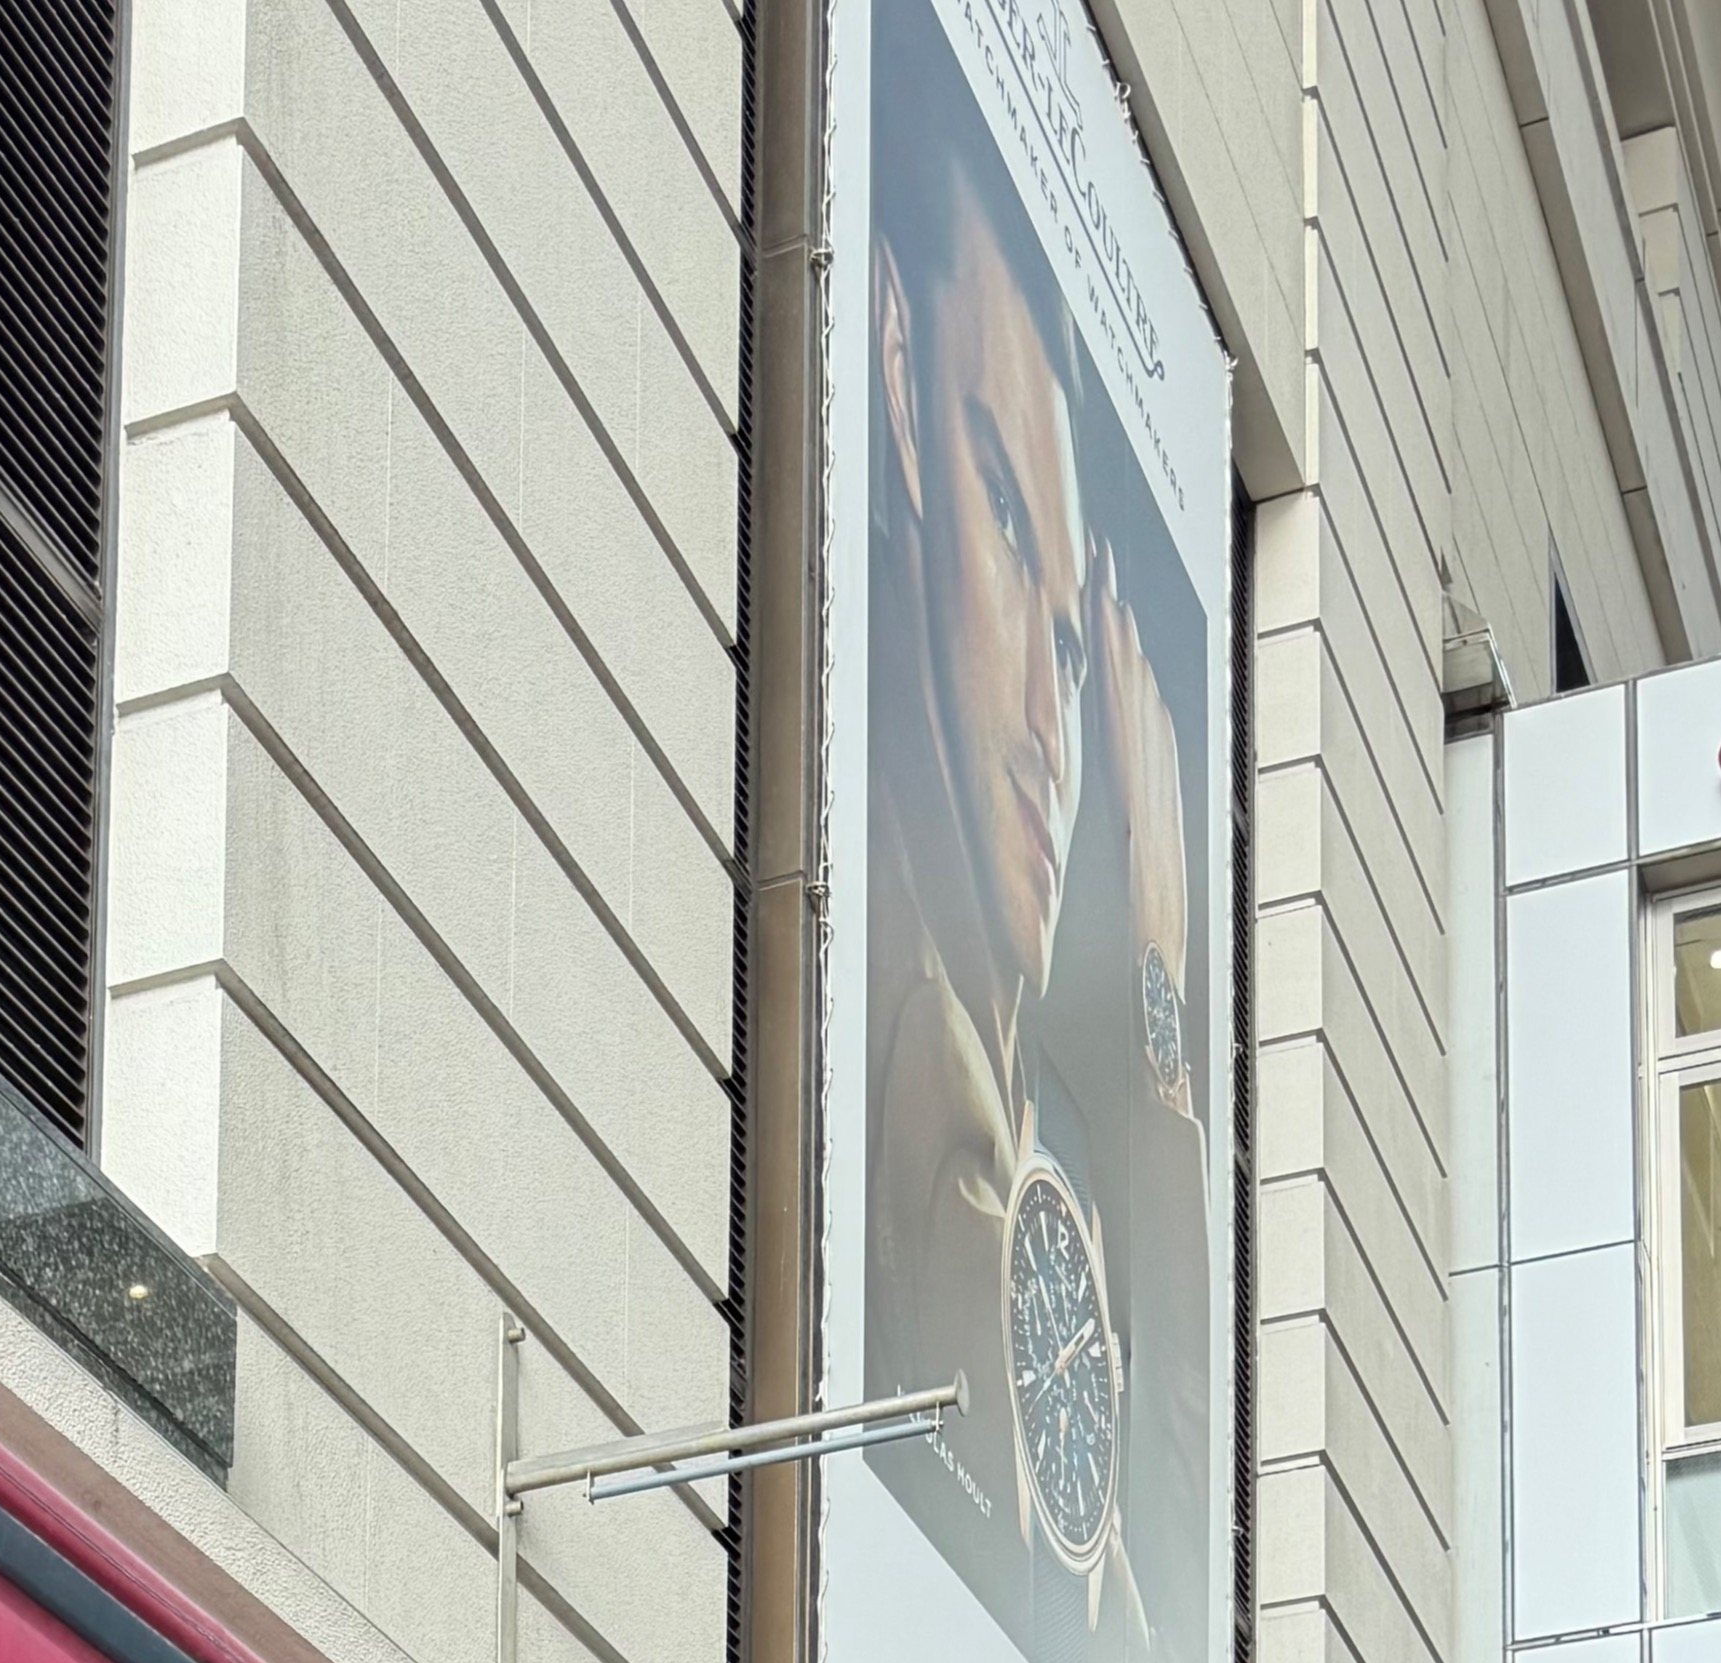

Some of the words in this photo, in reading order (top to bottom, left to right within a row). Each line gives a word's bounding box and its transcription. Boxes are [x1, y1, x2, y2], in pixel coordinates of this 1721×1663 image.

[956, 0, 1058, 223] ATCHMAKER
[1064, 225, 1082, 269] OF
[1086, 274, 1185, 512] WATCHMAKERS
[957, 1461, 992, 1519] HOULT
